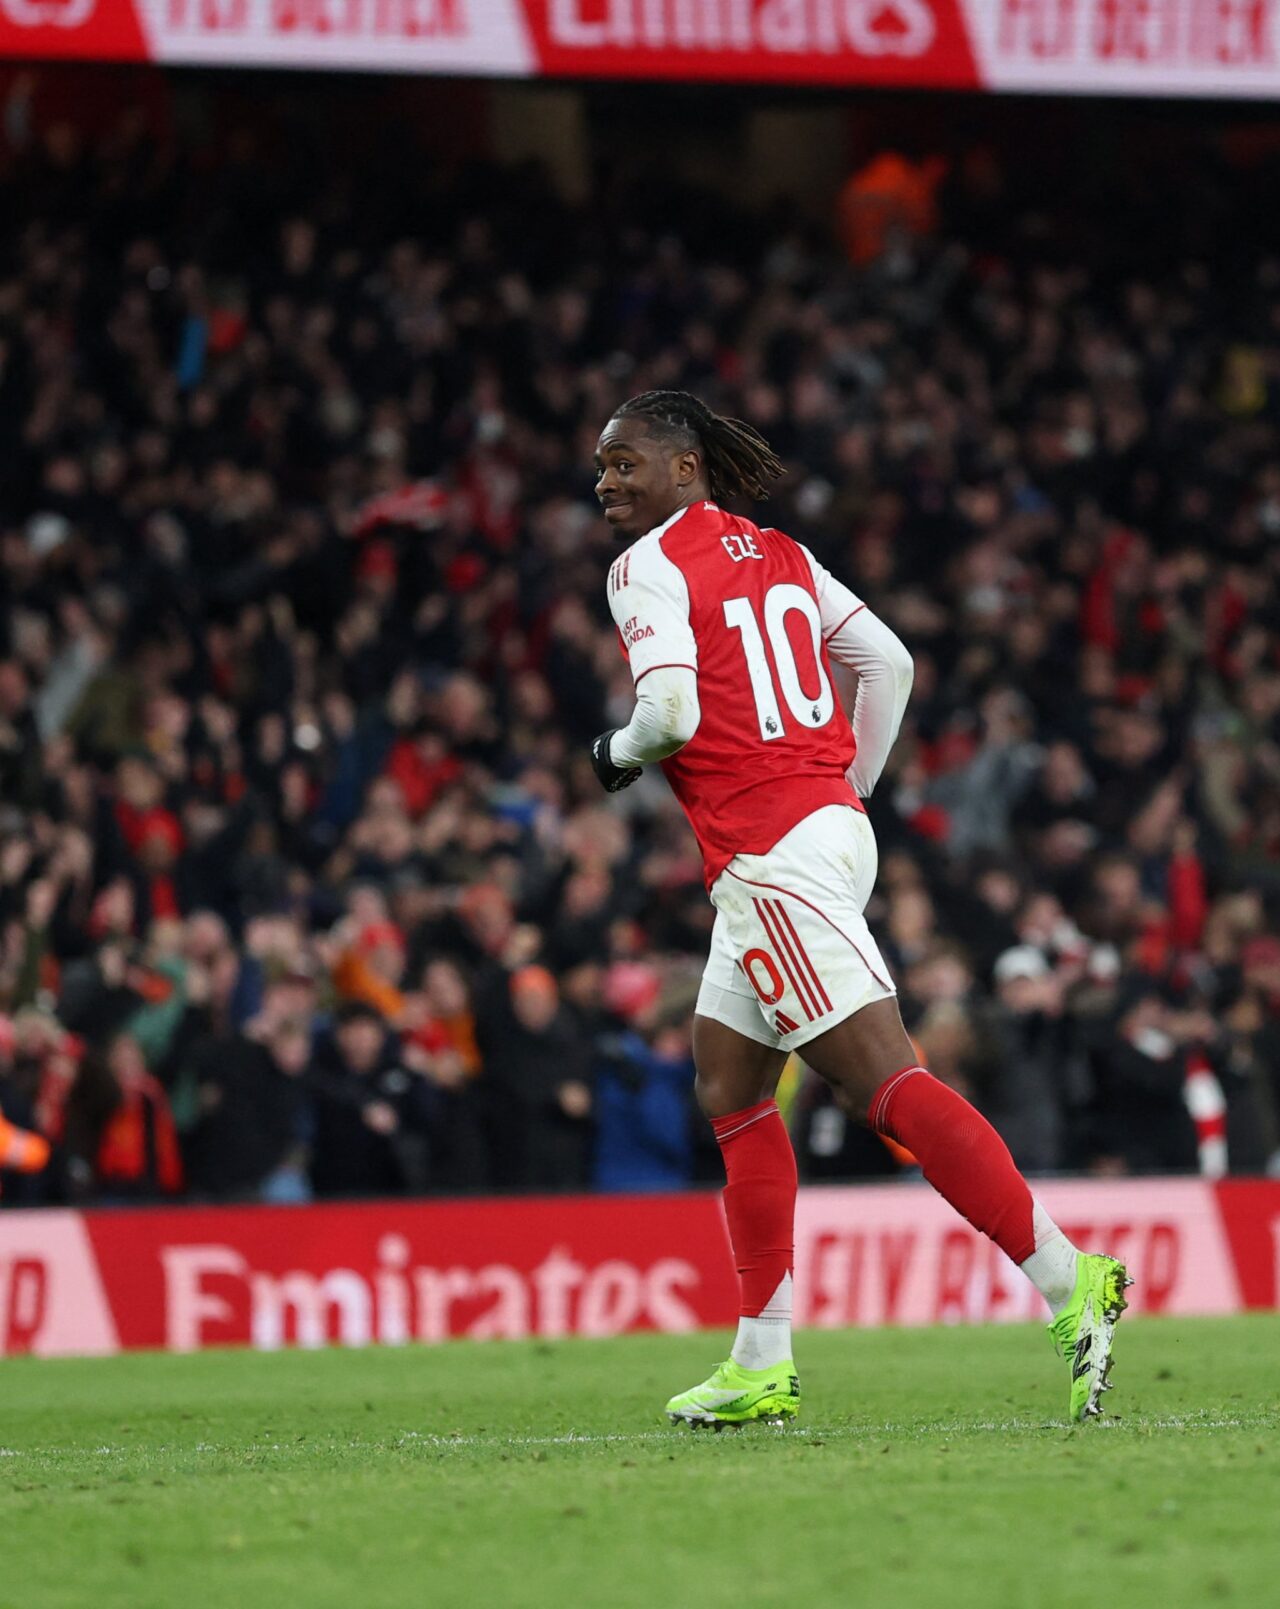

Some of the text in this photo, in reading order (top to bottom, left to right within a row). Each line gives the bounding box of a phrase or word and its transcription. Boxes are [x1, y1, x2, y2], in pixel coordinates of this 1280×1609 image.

[720, 533, 764, 562] EZE
[723, 583, 834, 742] 10
[160, 1233, 700, 1352] Emirates
